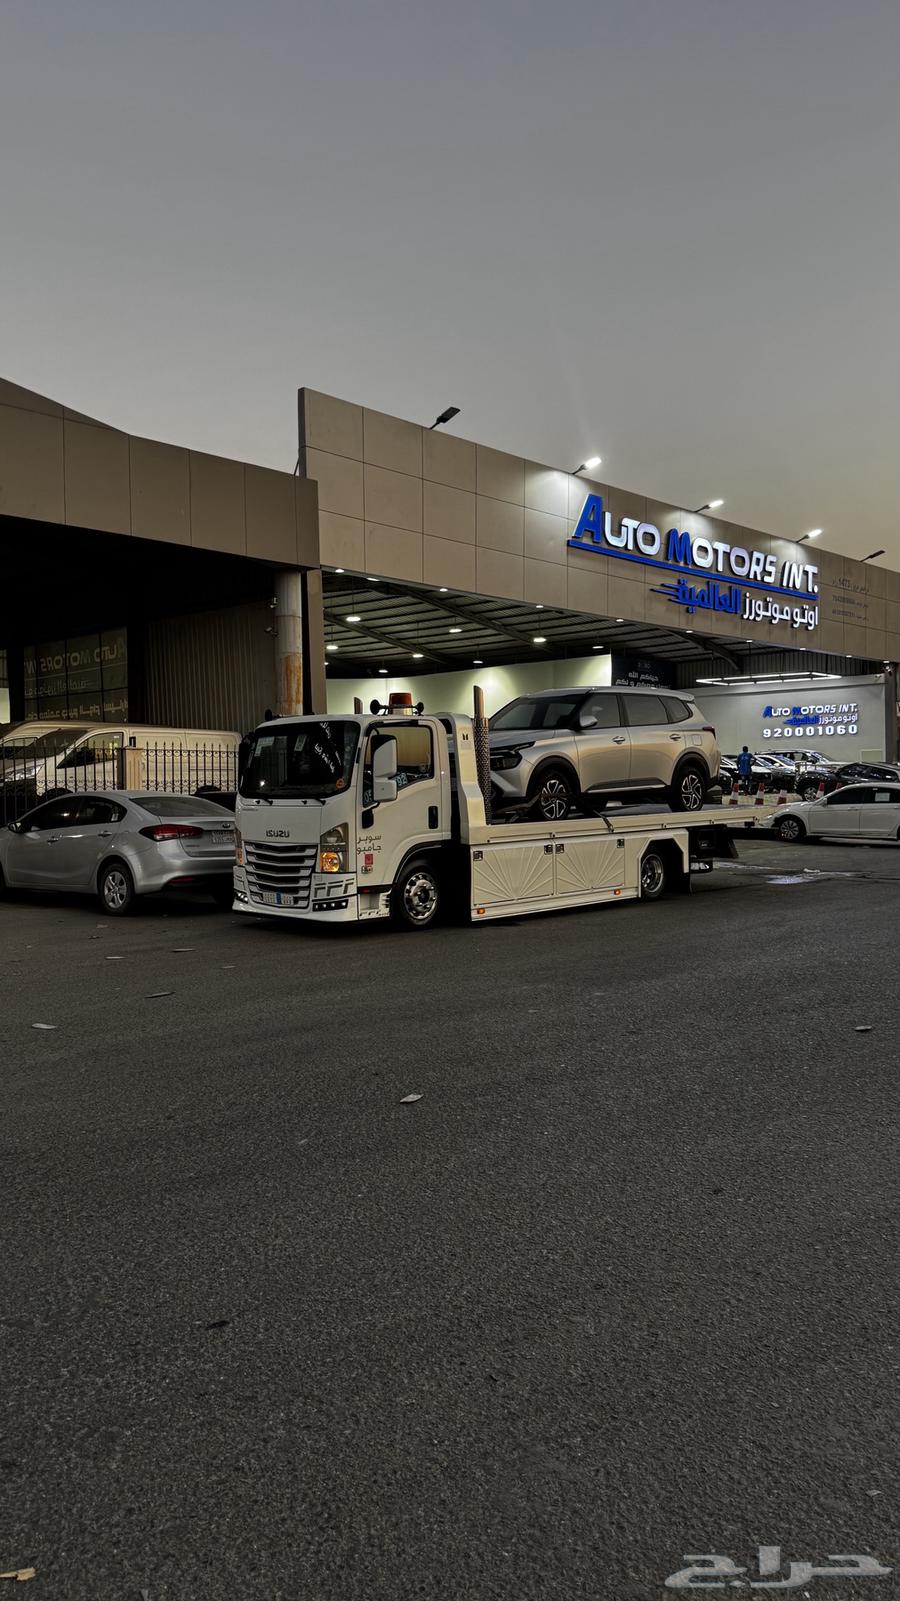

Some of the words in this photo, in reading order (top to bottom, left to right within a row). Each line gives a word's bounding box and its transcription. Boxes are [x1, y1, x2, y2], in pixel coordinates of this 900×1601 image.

[572, 492, 661, 556] AUTO
[666, 528, 777, 583] MOTORS
[782, 560, 819, 593] INT.
[668, 579, 742, 614] العالمية
[742, 591, 791, 622] موتورز
[763, 705, 790, 718] AUTO
[792, 704, 836, 716] MOTORS
[762, 724, 858, 738] 920001060
[266, 829, 290, 838] ISUZU
